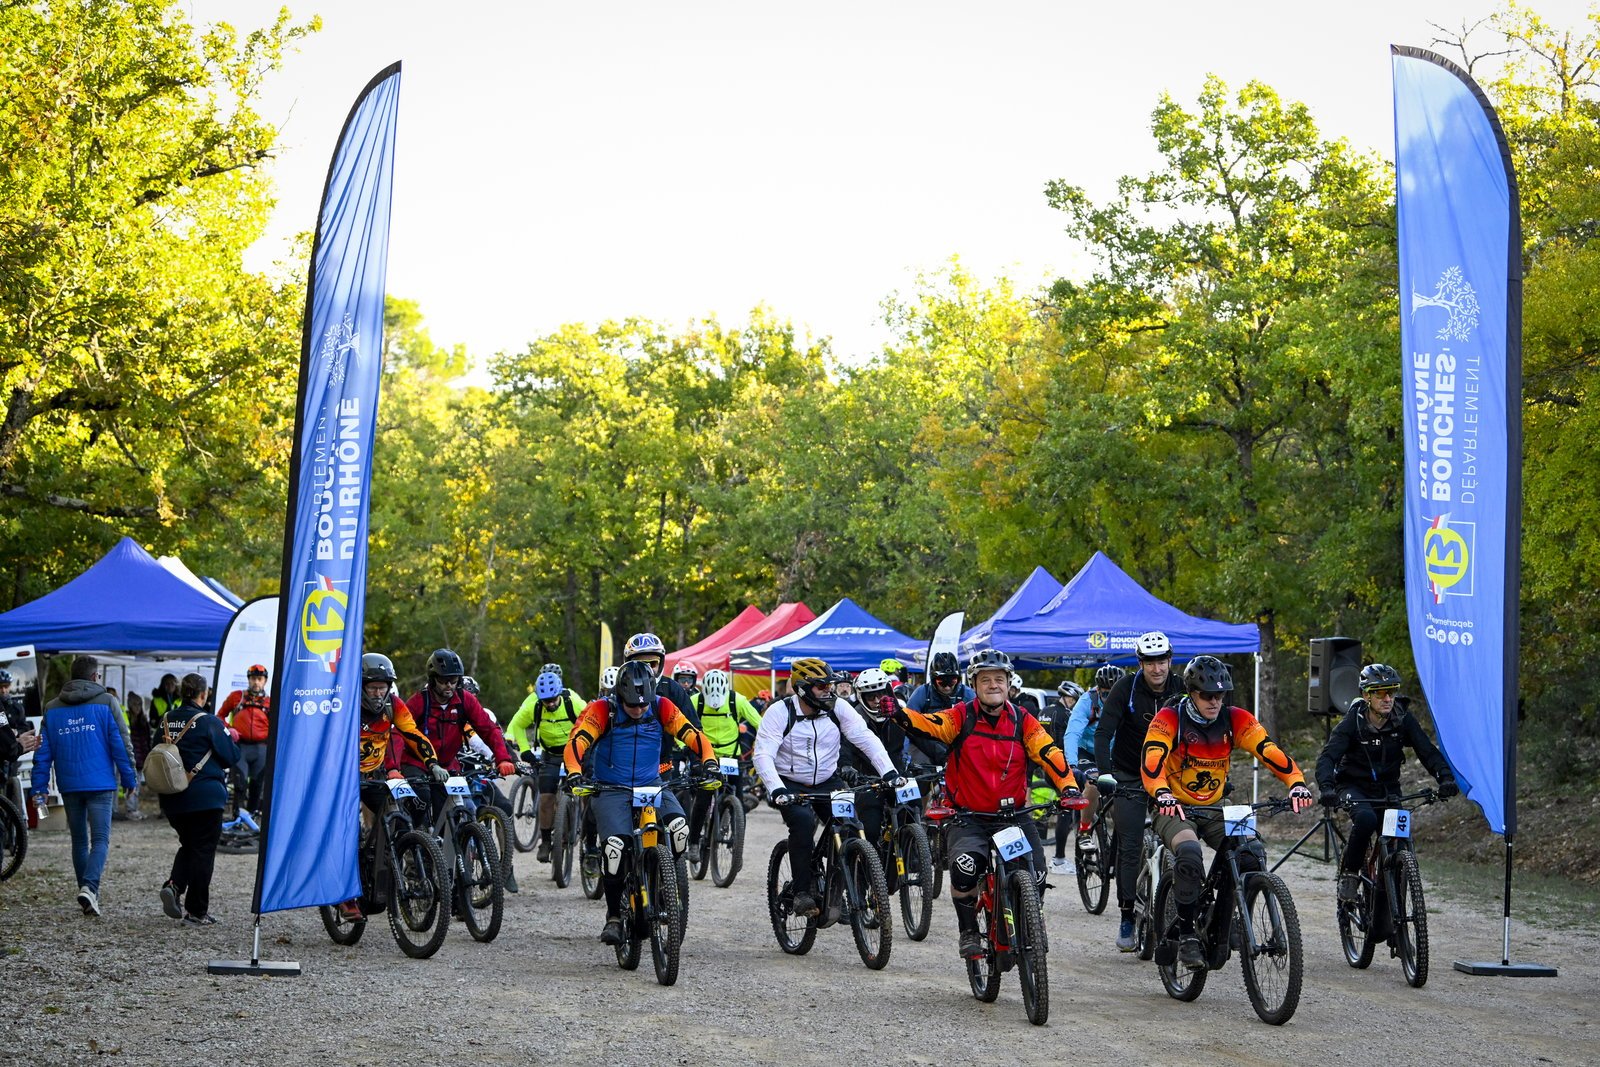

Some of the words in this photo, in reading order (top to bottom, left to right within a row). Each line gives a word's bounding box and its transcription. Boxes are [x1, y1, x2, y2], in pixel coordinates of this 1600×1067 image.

[817, 627, 894, 635] GIANT
[68, 717, 85, 725] Staff
[160, 720, 185, 729] Cmité
[188, 721, 197, 729] 3
[81, 724, 96, 732] FFC
[901, 788, 914, 798] 41
[838, 804, 852, 813] 34
[1397, 815, 1407, 832] 46
[1006, 840, 1024, 856] 29
